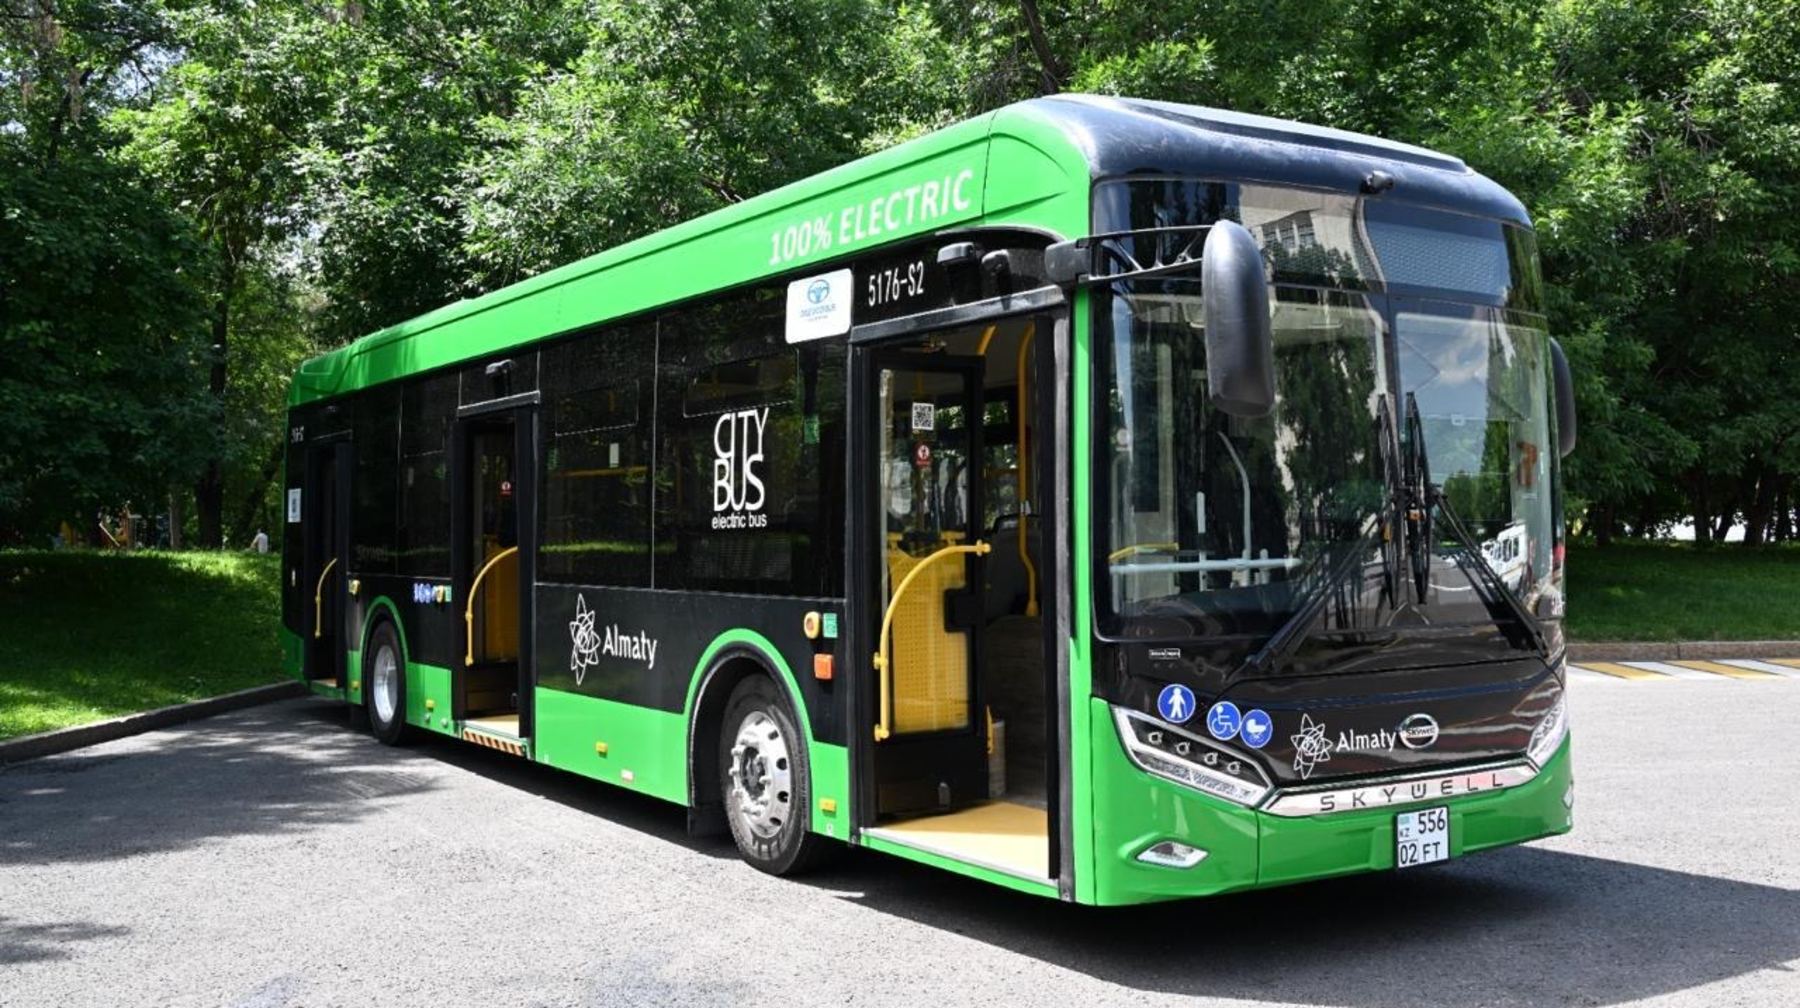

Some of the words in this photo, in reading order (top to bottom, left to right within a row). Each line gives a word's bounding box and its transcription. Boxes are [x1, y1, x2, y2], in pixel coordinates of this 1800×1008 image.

[769, 213, 833, 266] 100%
[839, 169, 973, 245] ELECTRIC
[868, 261, 924, 307] 5176-S2
[714, 407, 769, 459] CITY
[714, 454, 765, 511] BUS
[711, 512, 746, 529] electric
[748, 511, 767, 527] bus
[602, 623, 657, 670] Almaty
[1335, 728, 1397, 752] Almaty
[1320, 773, 1503, 811] SKYWELL
[1418, 809, 1446, 834] 556
[1400, 843, 1417, 865] 02
[1422, 841, 1441, 862] FT
